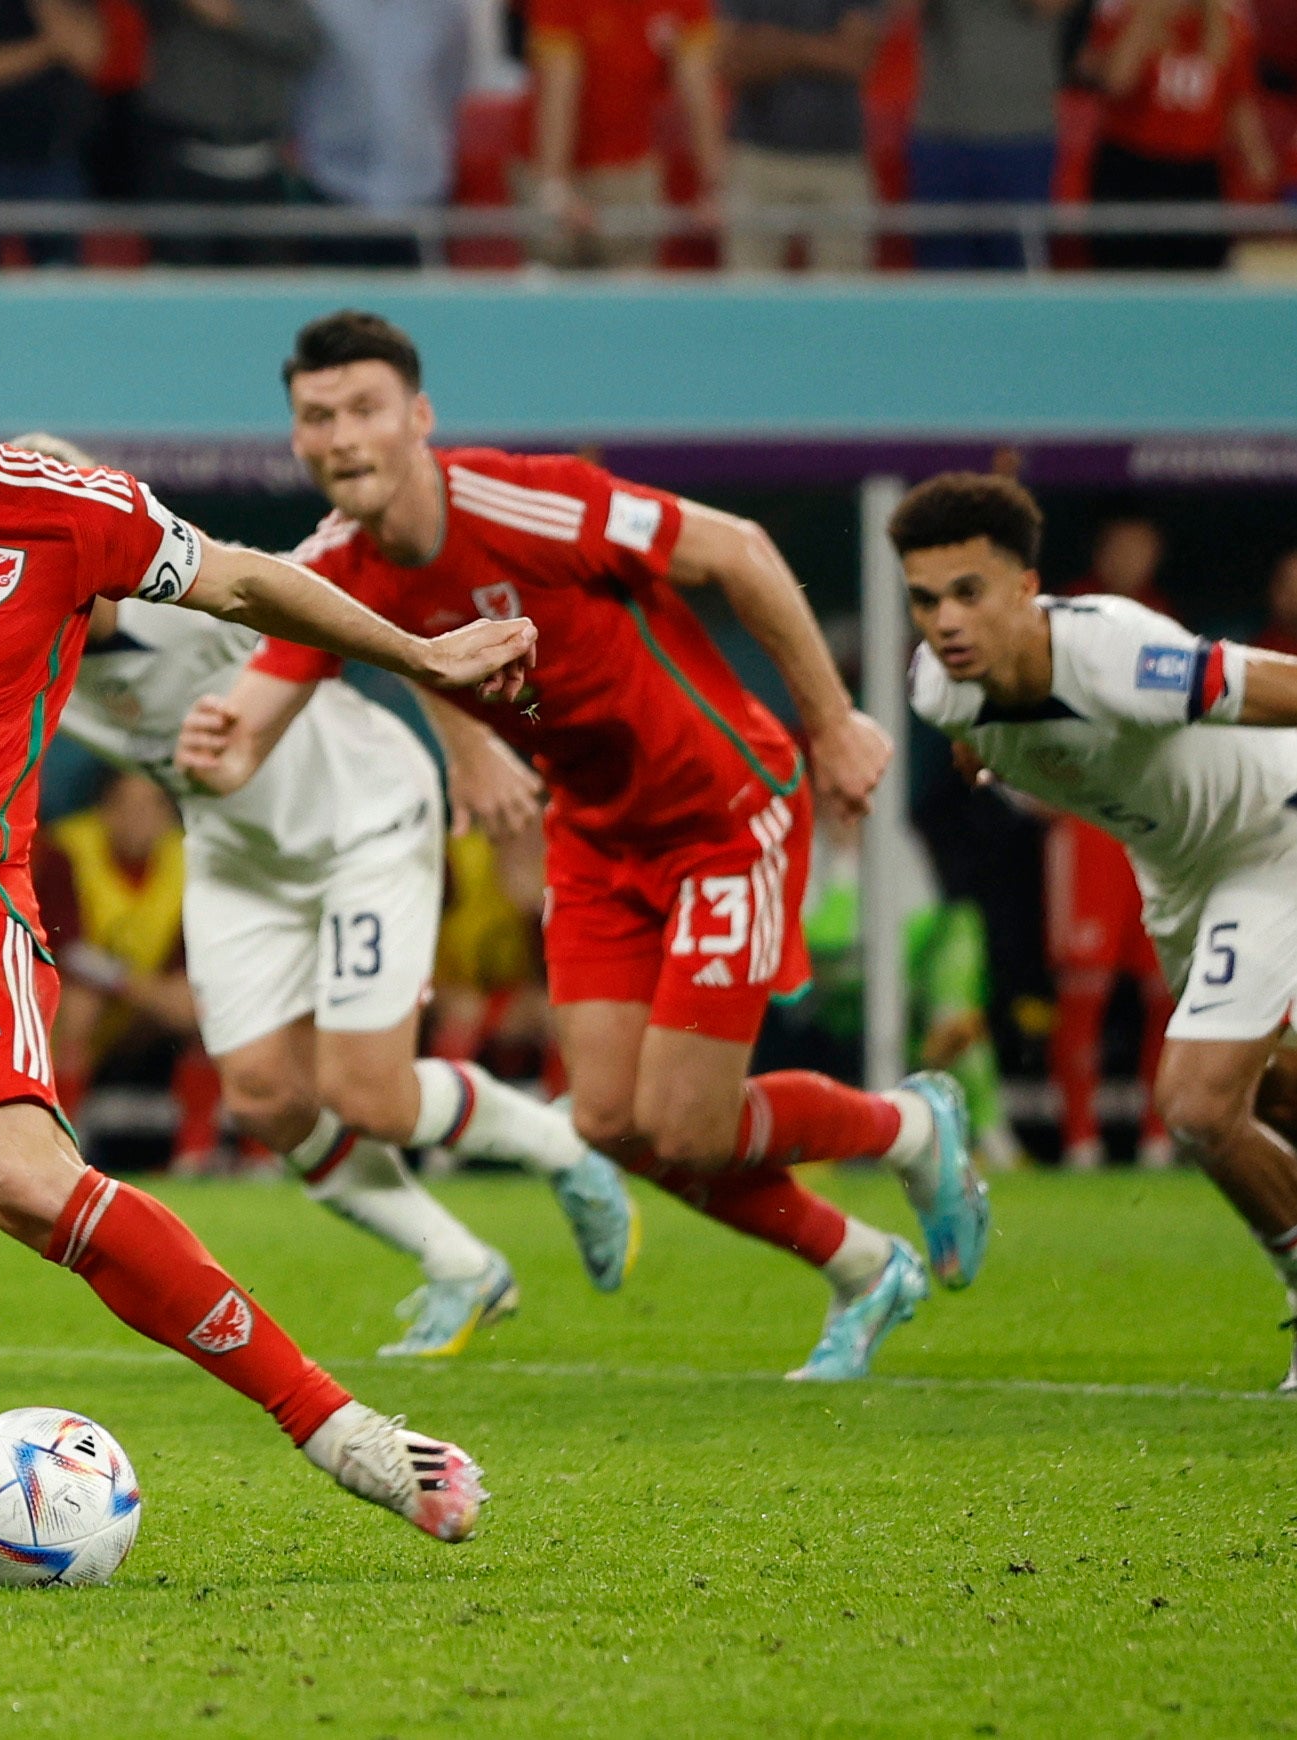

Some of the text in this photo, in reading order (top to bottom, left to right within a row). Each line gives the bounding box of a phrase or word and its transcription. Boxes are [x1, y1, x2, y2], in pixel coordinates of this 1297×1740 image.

[171, 519, 185, 541] N
[328, 910, 382, 979] 13
[670, 875, 750, 956] 13
[1203, 921, 1239, 985] 5
